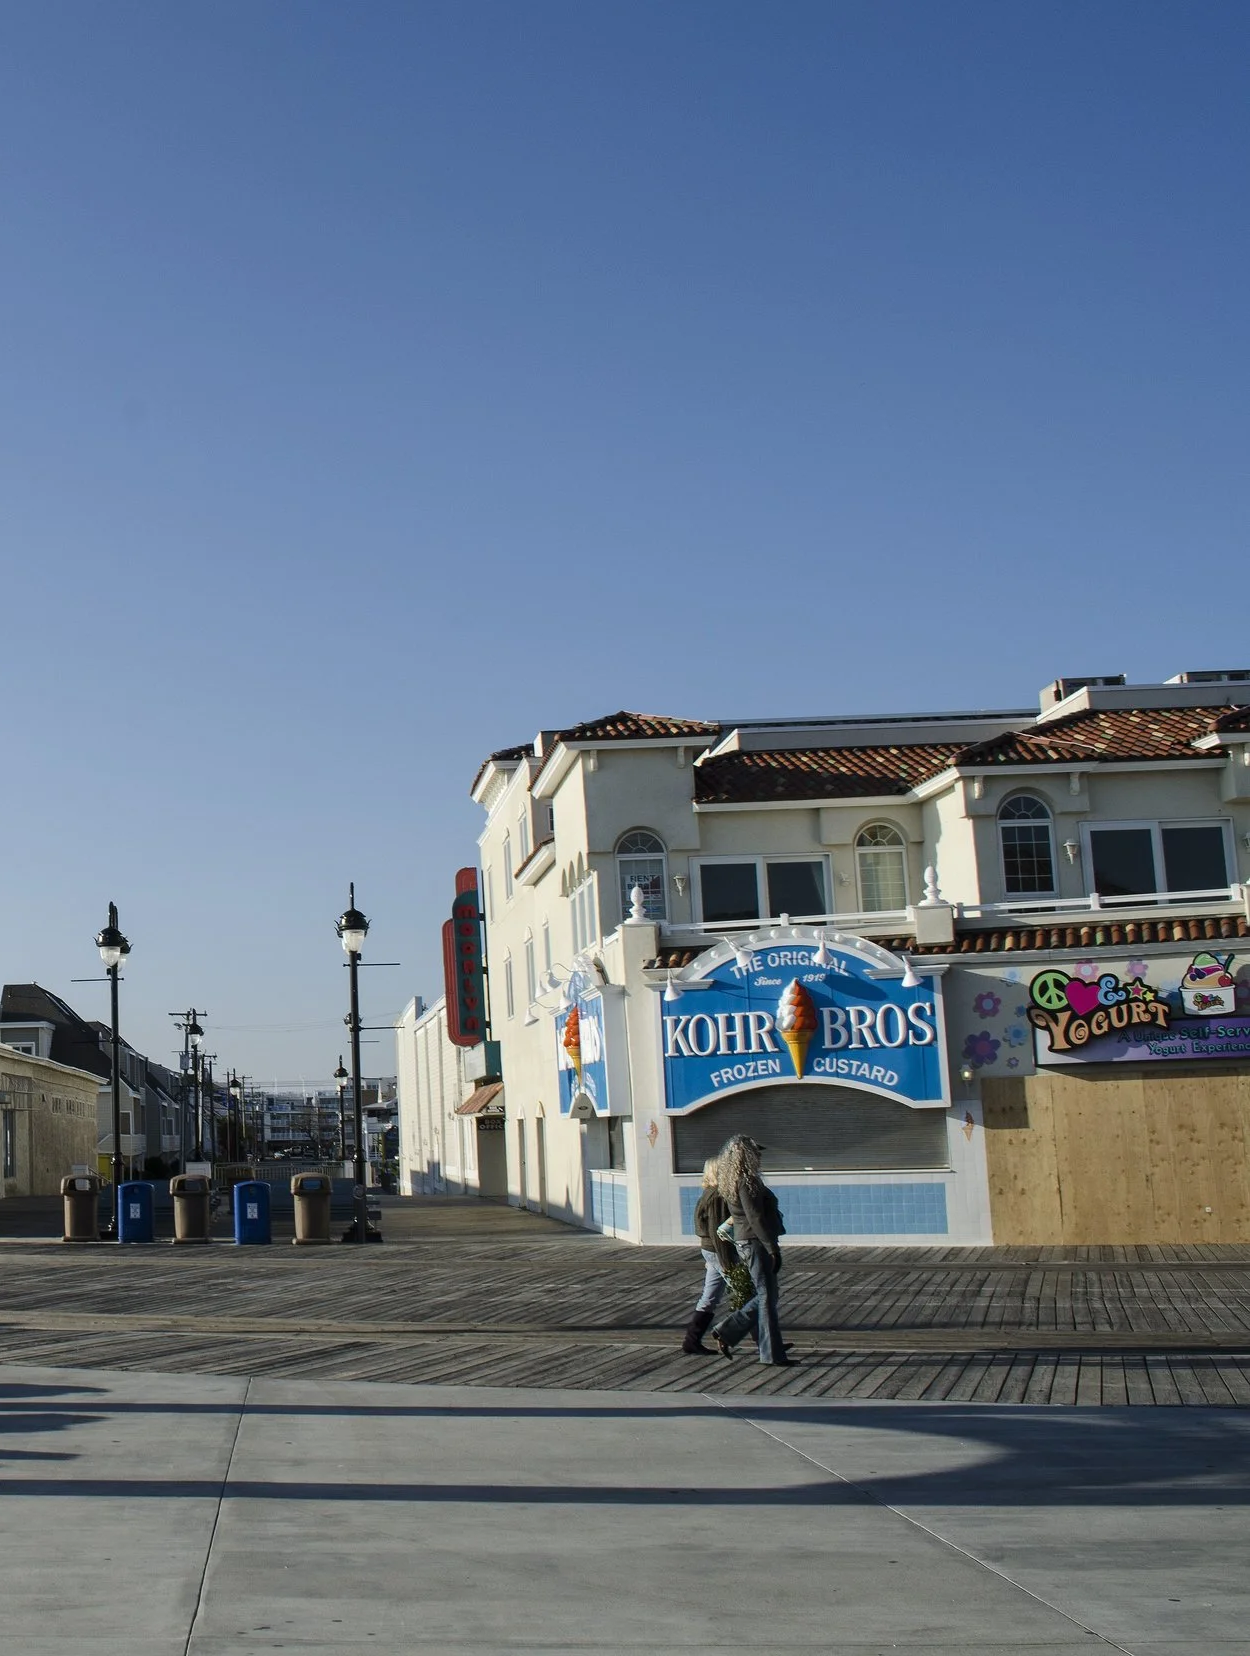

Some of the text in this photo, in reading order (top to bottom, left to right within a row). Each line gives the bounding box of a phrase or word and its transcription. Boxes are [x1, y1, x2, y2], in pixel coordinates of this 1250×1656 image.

[766, 950, 850, 978] ORIGIAL
[753, 973, 826, 987] Since 1919
[662, 1001, 936, 1058] KOHR BROS
[1032, 1001, 1170, 1051] YOGURT
[1117, 1030, 1131, 1044] A
[1133, 1029, 1177, 1044] Unique
[1148, 1041, 1187, 1056] Yogurt
[709, 1057, 900, 1088] FROZEN CUSTARD
